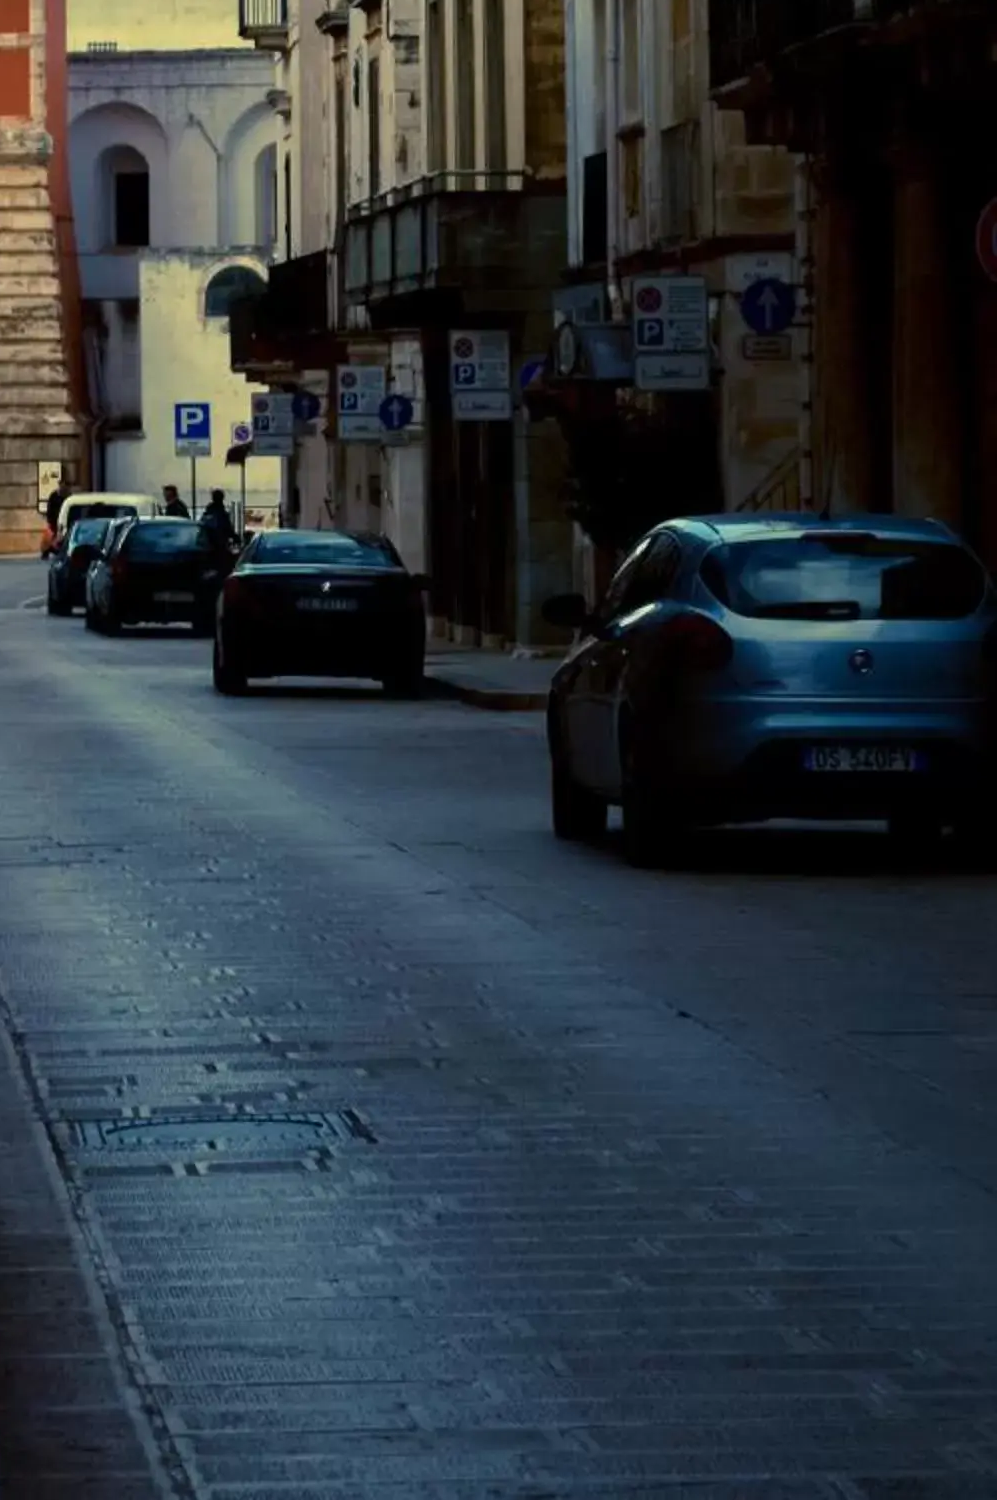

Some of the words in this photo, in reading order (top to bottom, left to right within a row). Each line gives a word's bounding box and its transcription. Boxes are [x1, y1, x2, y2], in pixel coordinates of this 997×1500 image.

[643, 321, 660, 343] P
[459, 366, 473, 381] P
[180, 408, 204, 435] P
